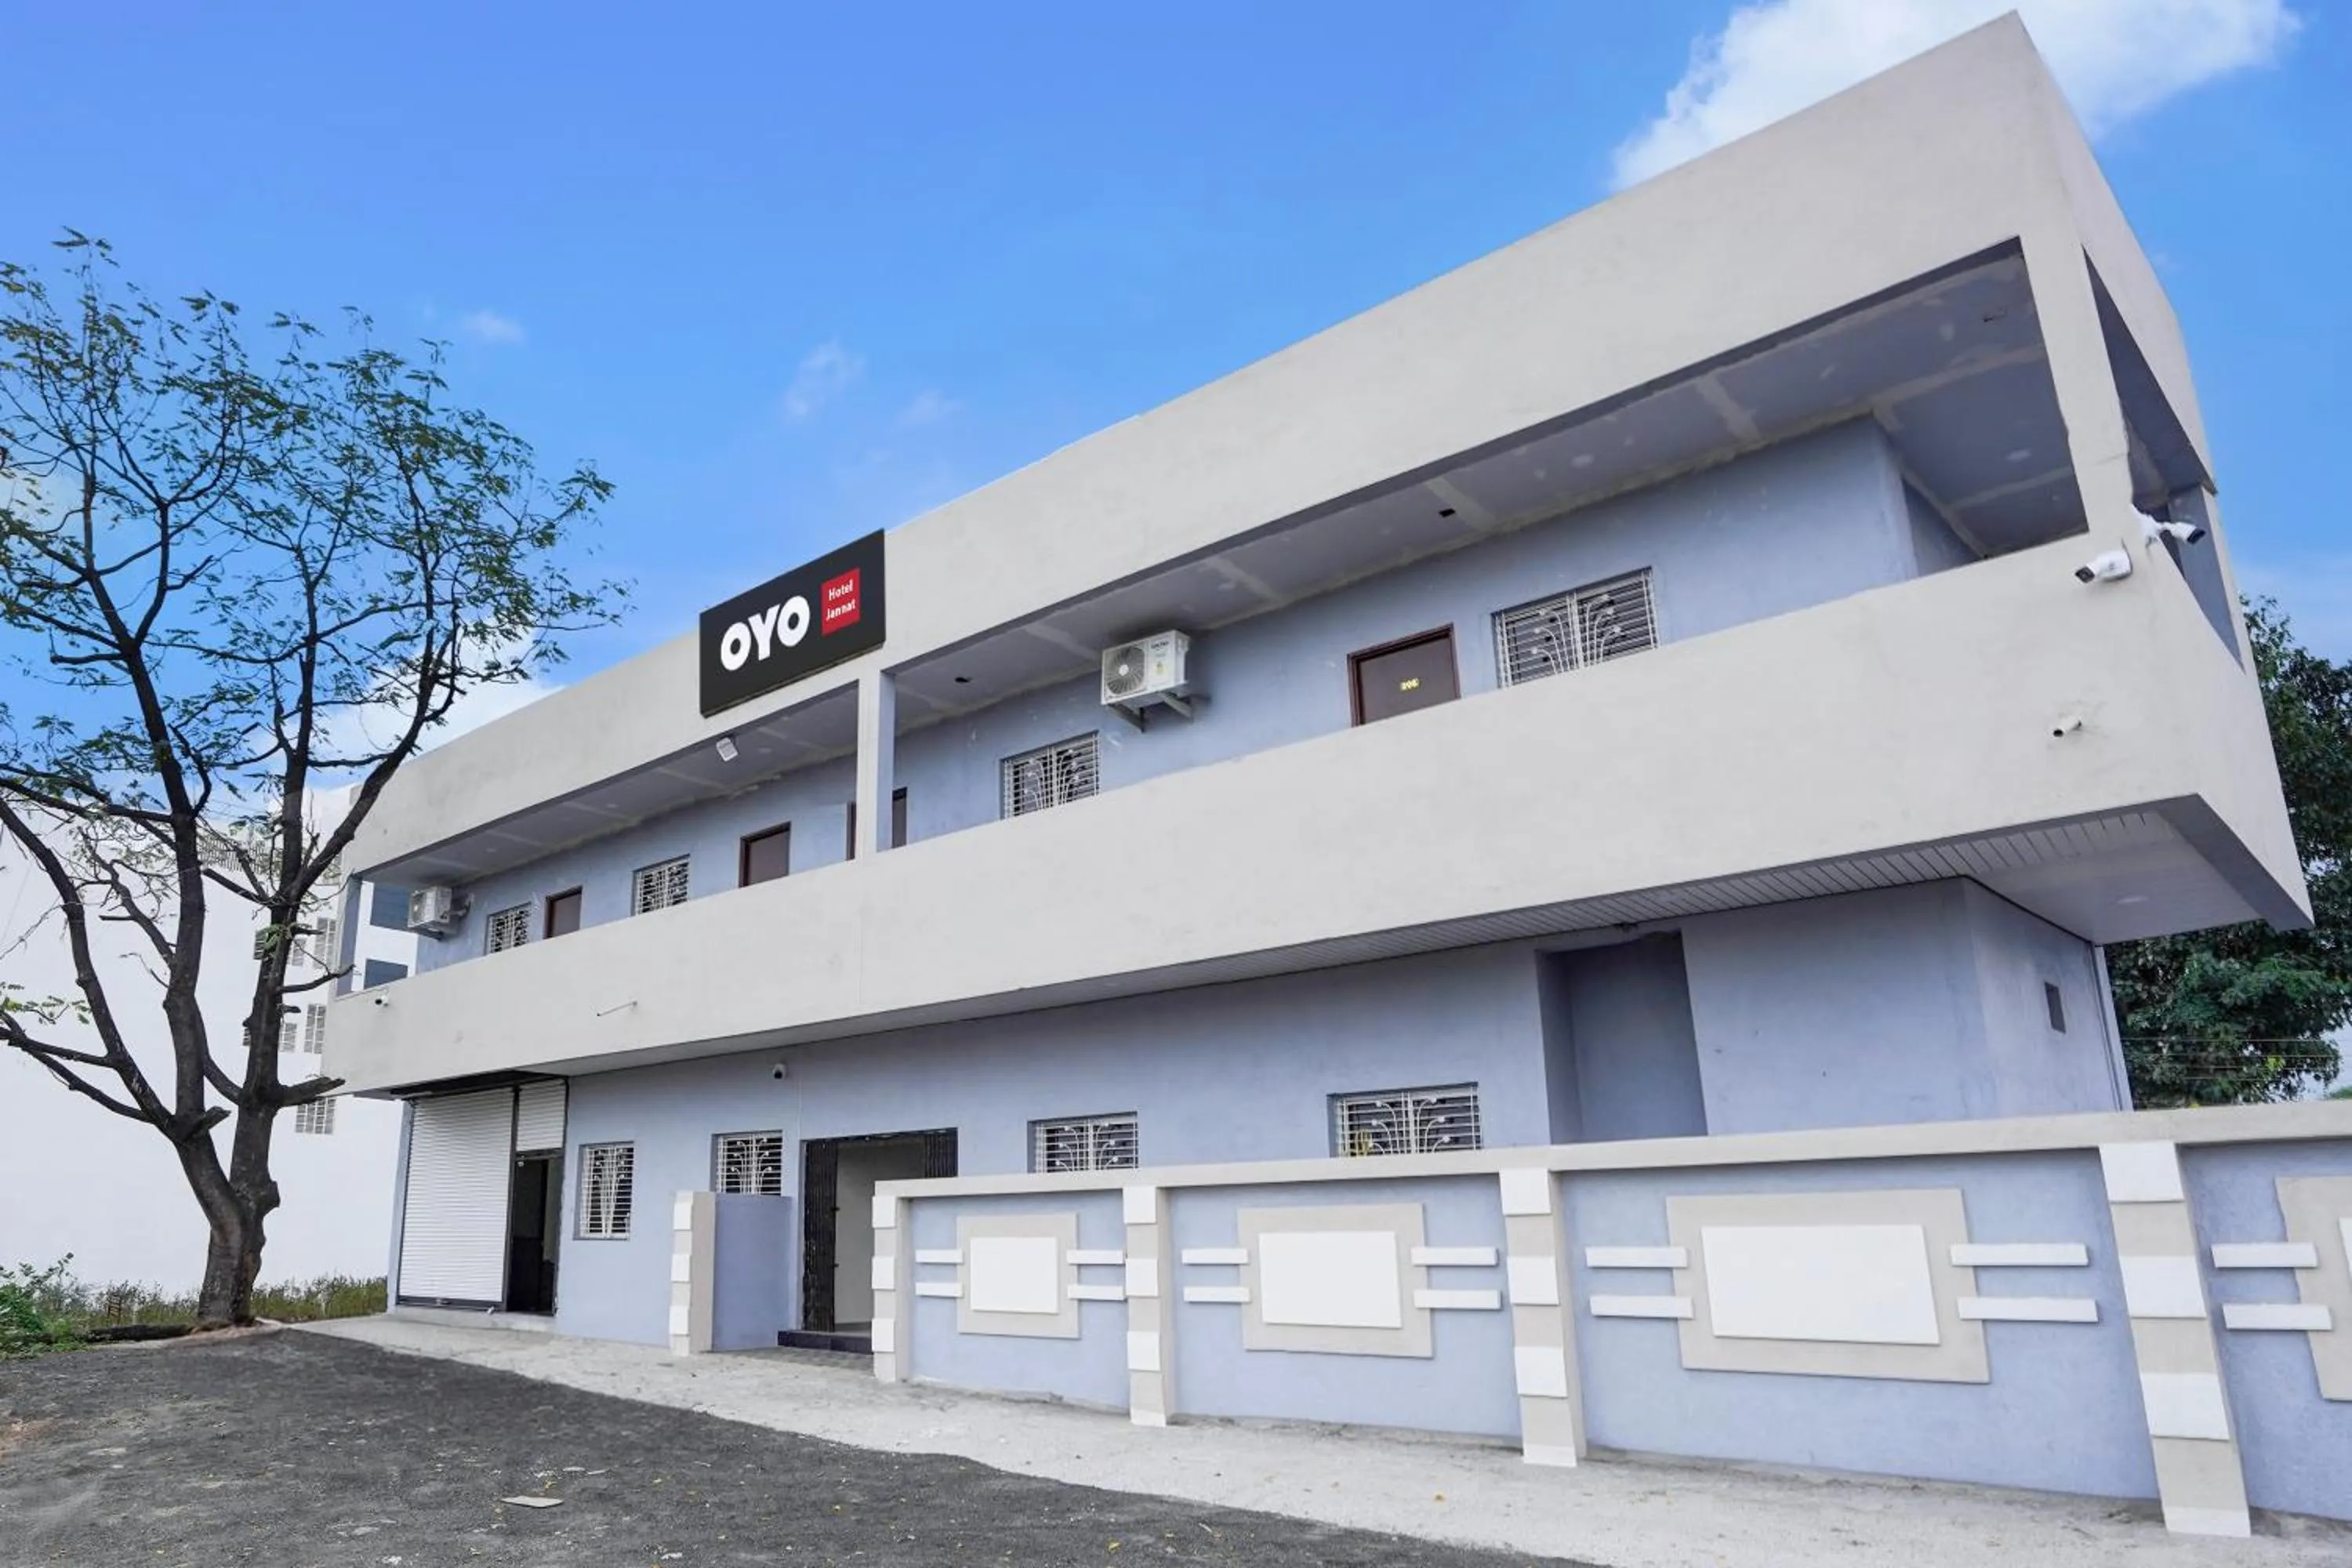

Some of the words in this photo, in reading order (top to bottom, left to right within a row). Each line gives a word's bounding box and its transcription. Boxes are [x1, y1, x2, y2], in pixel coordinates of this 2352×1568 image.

[829, 579, 854, 601] Hotel
[826, 600, 855, 621] Jannat
[720, 596, 810, 672] OYO
